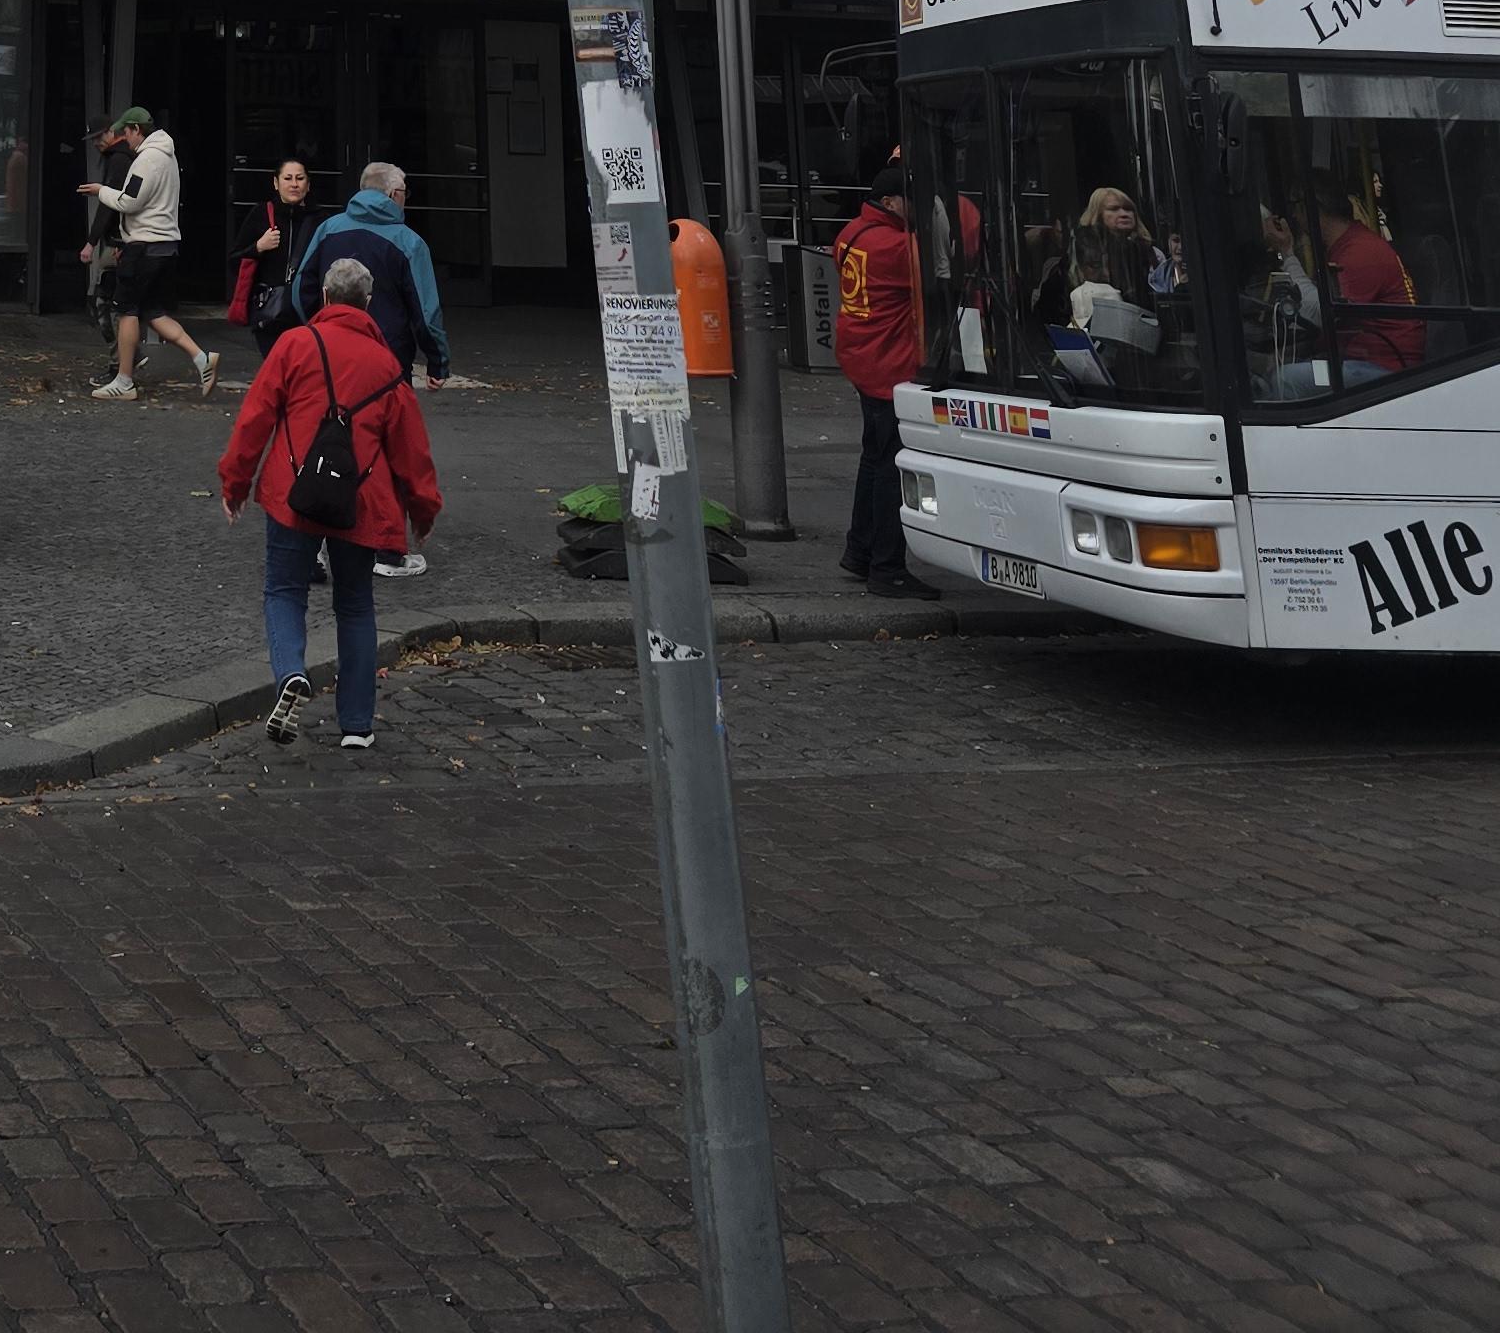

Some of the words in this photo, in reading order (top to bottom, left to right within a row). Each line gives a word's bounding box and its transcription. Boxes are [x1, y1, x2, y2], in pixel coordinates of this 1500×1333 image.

[816, 283, 831, 350] Abfall
[1258, 547, 1293, 555] Omnibus
[1295, 547, 1344, 555] Reisedienst
[1348, 520, 1493, 635] Alle
